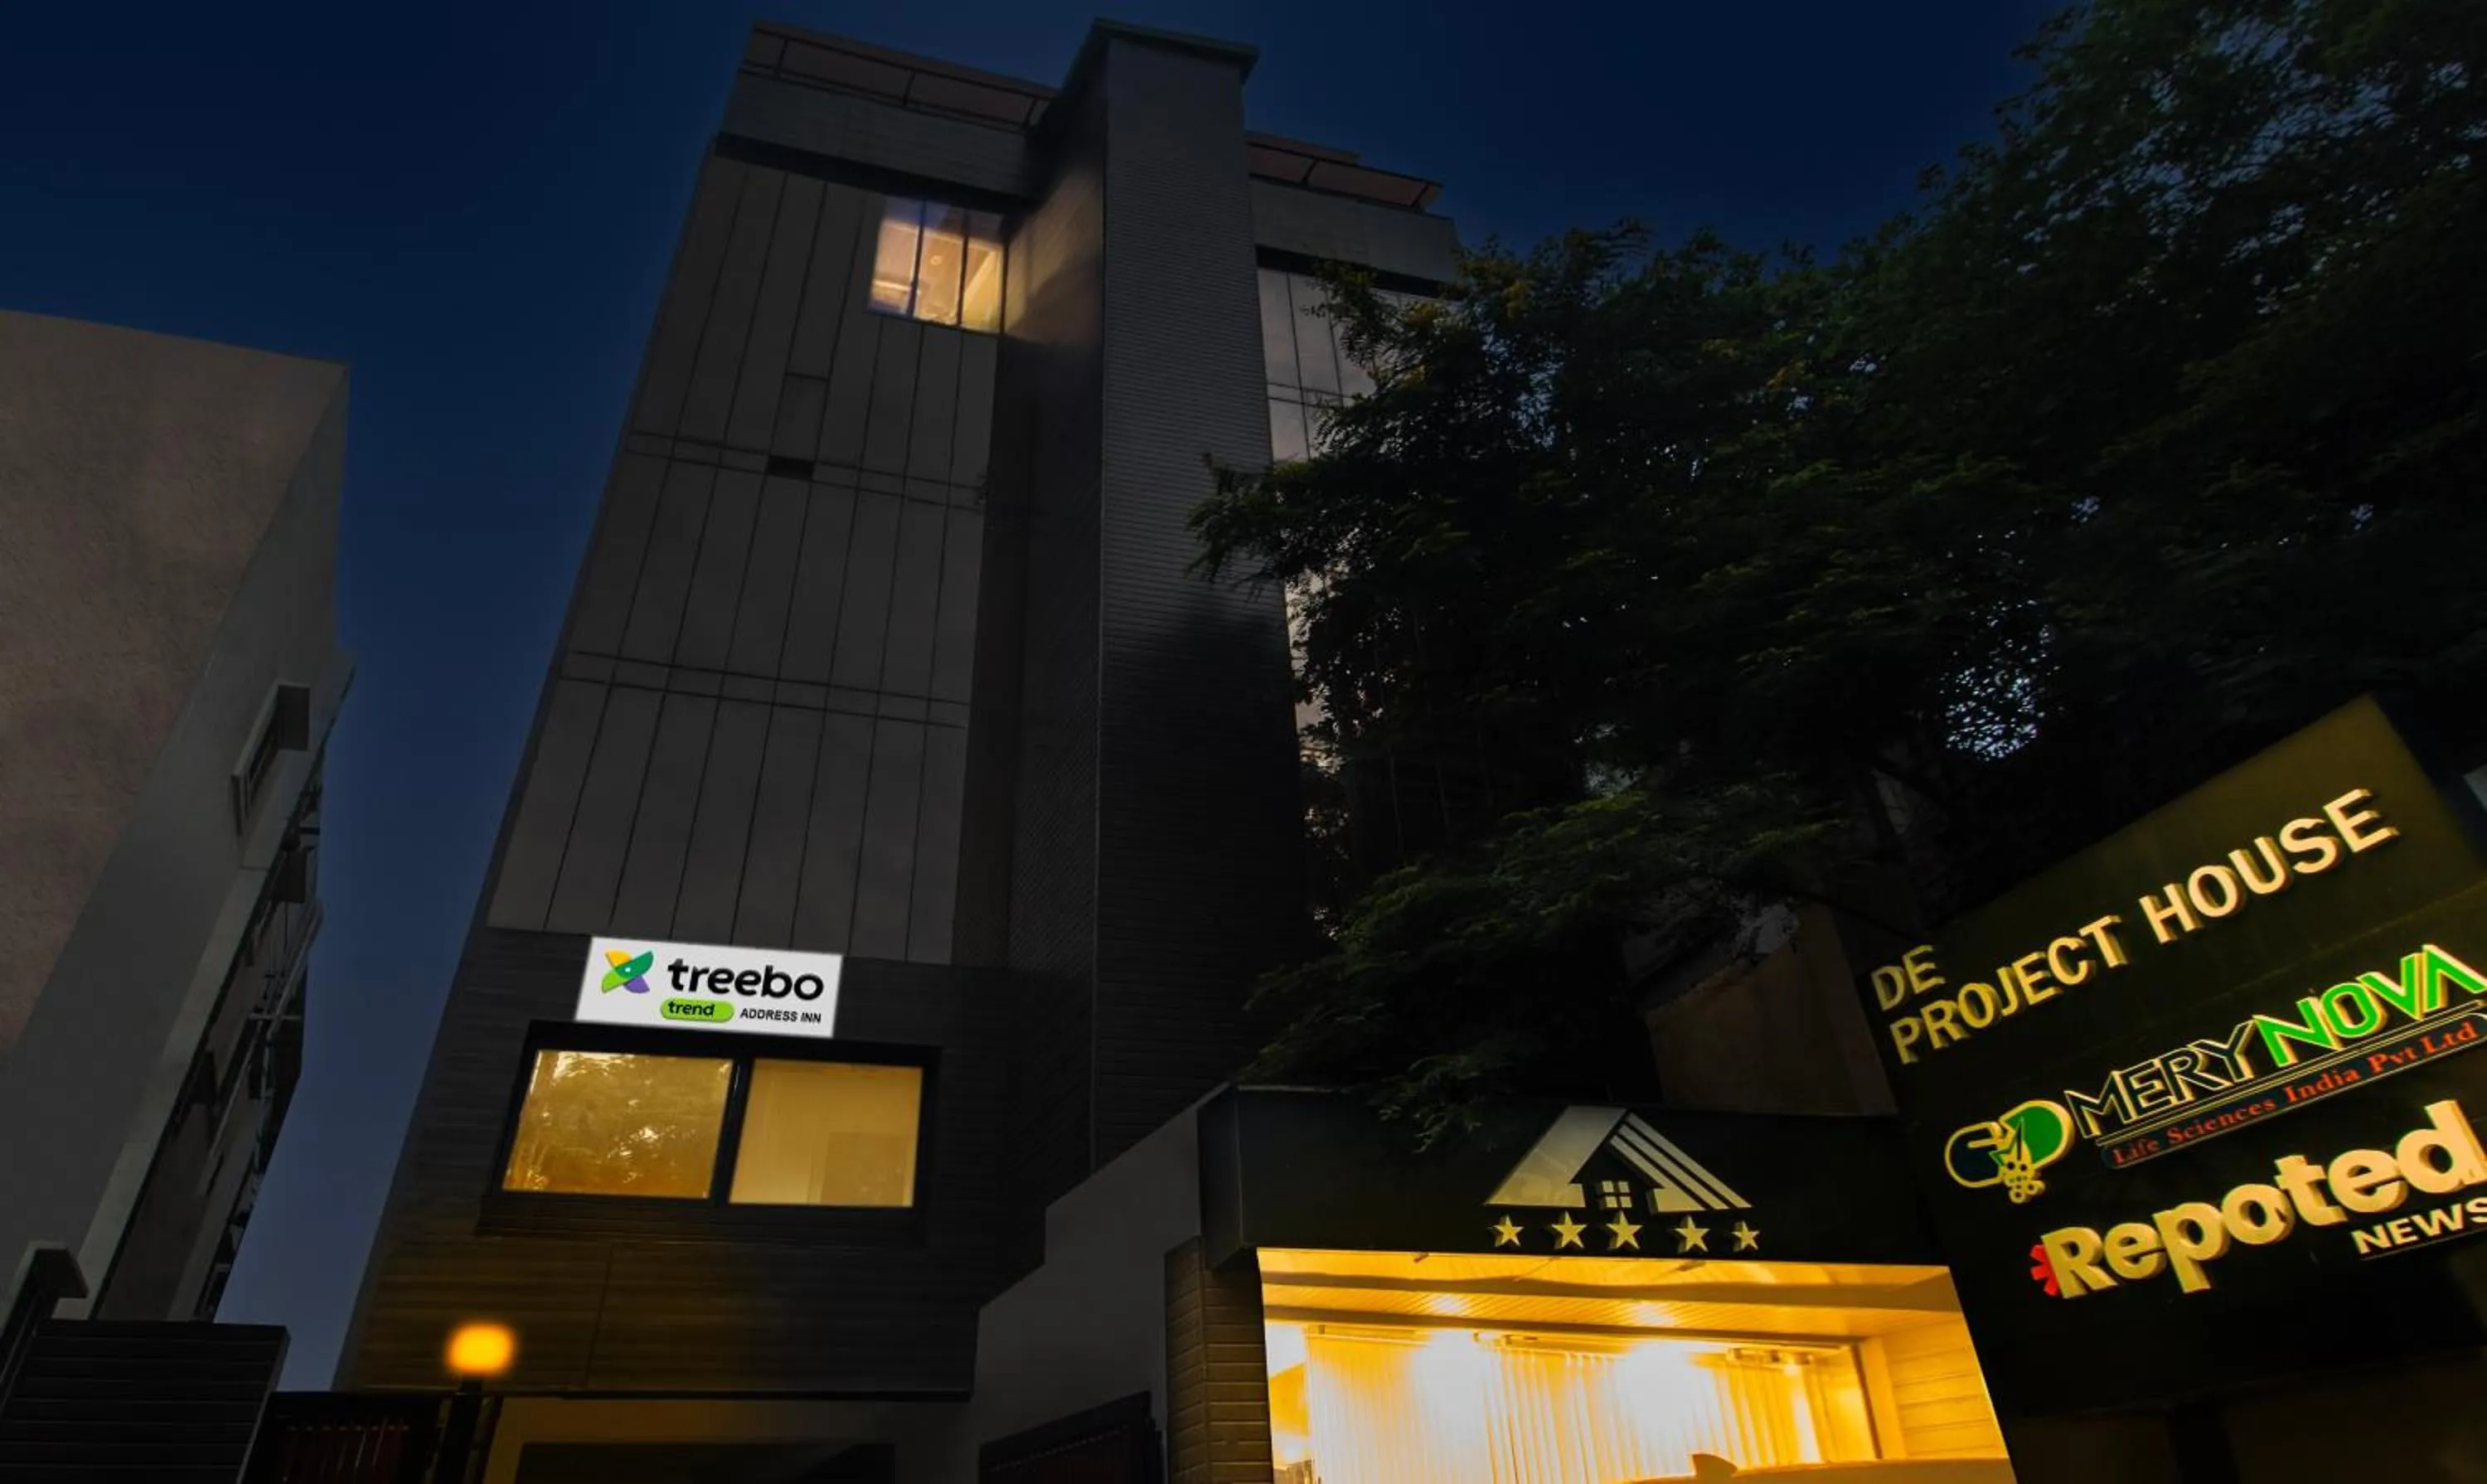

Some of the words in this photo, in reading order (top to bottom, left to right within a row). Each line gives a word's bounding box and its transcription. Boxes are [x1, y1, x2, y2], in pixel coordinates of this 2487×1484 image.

[1889, 914, 2129, 1065] PROJECT
[2139, 788, 2399, 944] HOUSE
[667, 958, 824, 1001] treebo
[1871, 944, 1946, 1011] DE
[667, 1000, 715, 1016] trend
[739, 1008, 798, 1022] ADDRESS
[800, 1011, 822, 1024] INN
[2113, 1137, 2160, 1166] Life
[2165, 1098, 2277, 1145] Sciences
[2283, 1066, 2361, 1103] India
[2367, 1046, 2418, 1074] Pvt
[2420, 1020, 2478, 1054] Ltd
[2041, 1098, 2487, 1300] Repoted
[2350, 1196, 2487, 1254] NEWS
